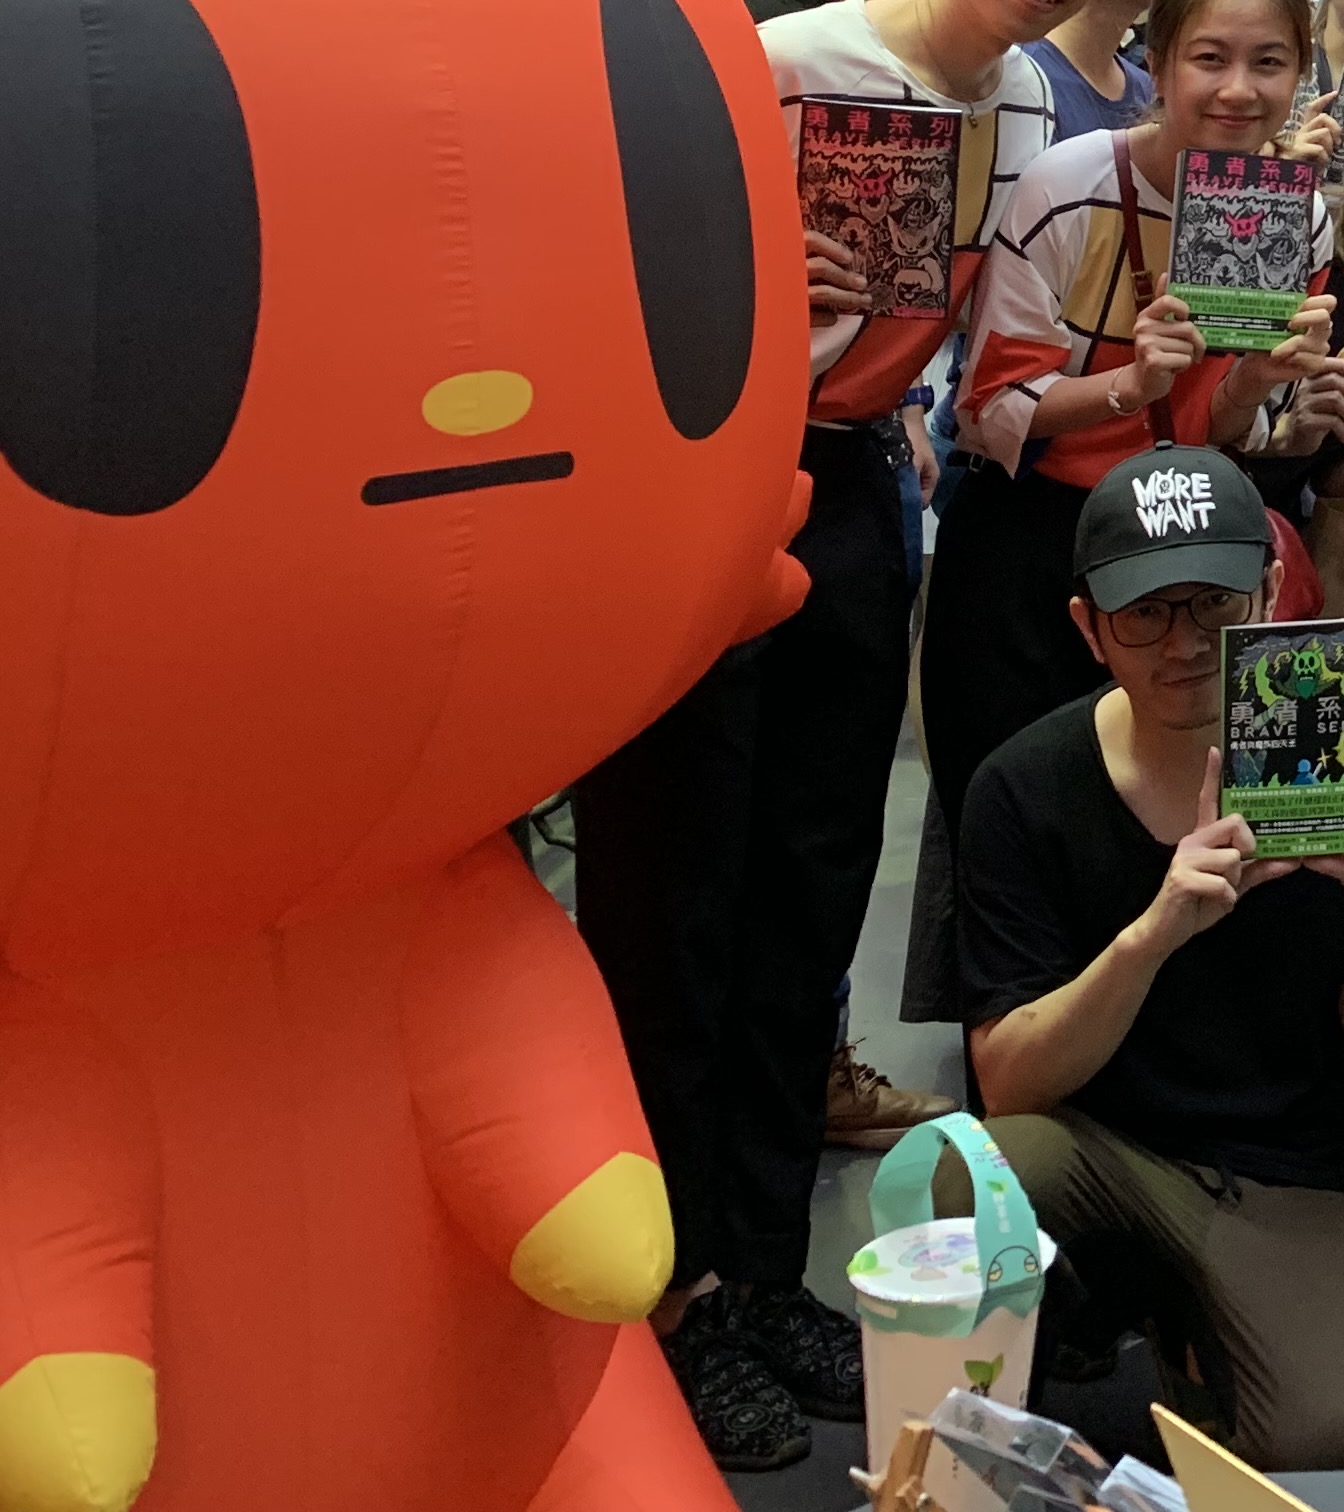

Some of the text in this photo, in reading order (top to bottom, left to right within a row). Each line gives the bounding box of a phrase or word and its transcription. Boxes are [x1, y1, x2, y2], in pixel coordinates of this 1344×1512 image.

[805, 106, 954, 137] 勇者系列
[1187, 152, 1313, 184] 勇者系列
[1132, 467, 1212, 502] MORE
[1136, 500, 1215, 538] WANT
[1231, 725, 1297, 738] BRAVE
